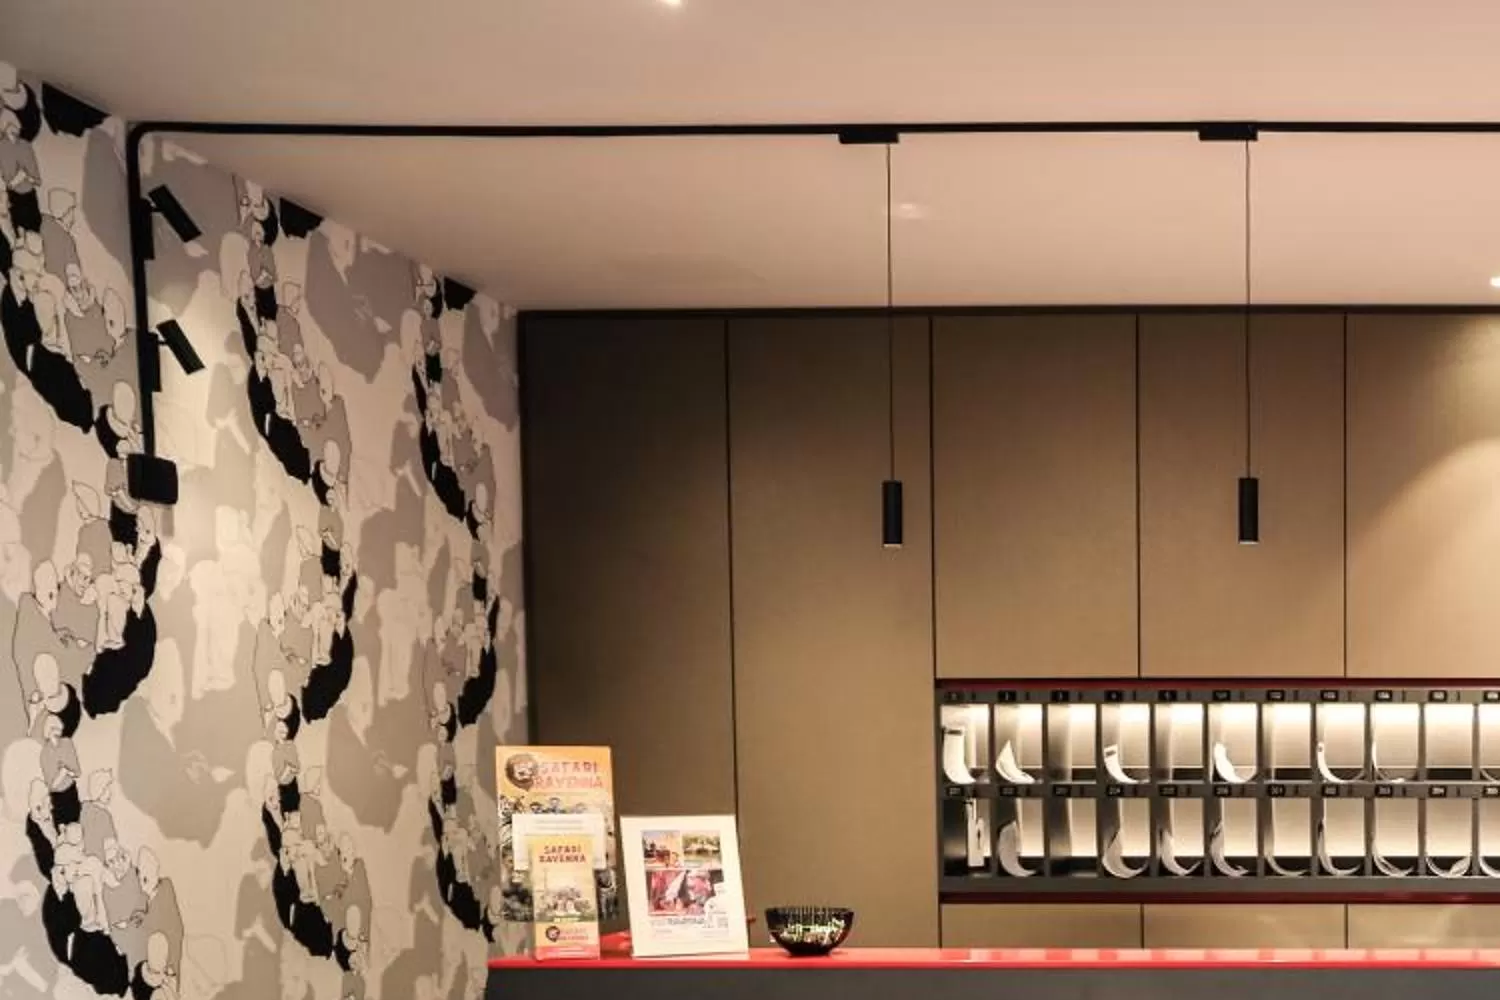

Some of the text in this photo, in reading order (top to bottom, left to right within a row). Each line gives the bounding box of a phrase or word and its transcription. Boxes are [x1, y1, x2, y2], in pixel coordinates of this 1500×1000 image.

[540, 760, 598, 774] SAFARI
[532, 775, 604, 789] RAVENNA
[543, 844, 582, 855] SAFARI
[538, 854, 587, 864] RAVENNA
